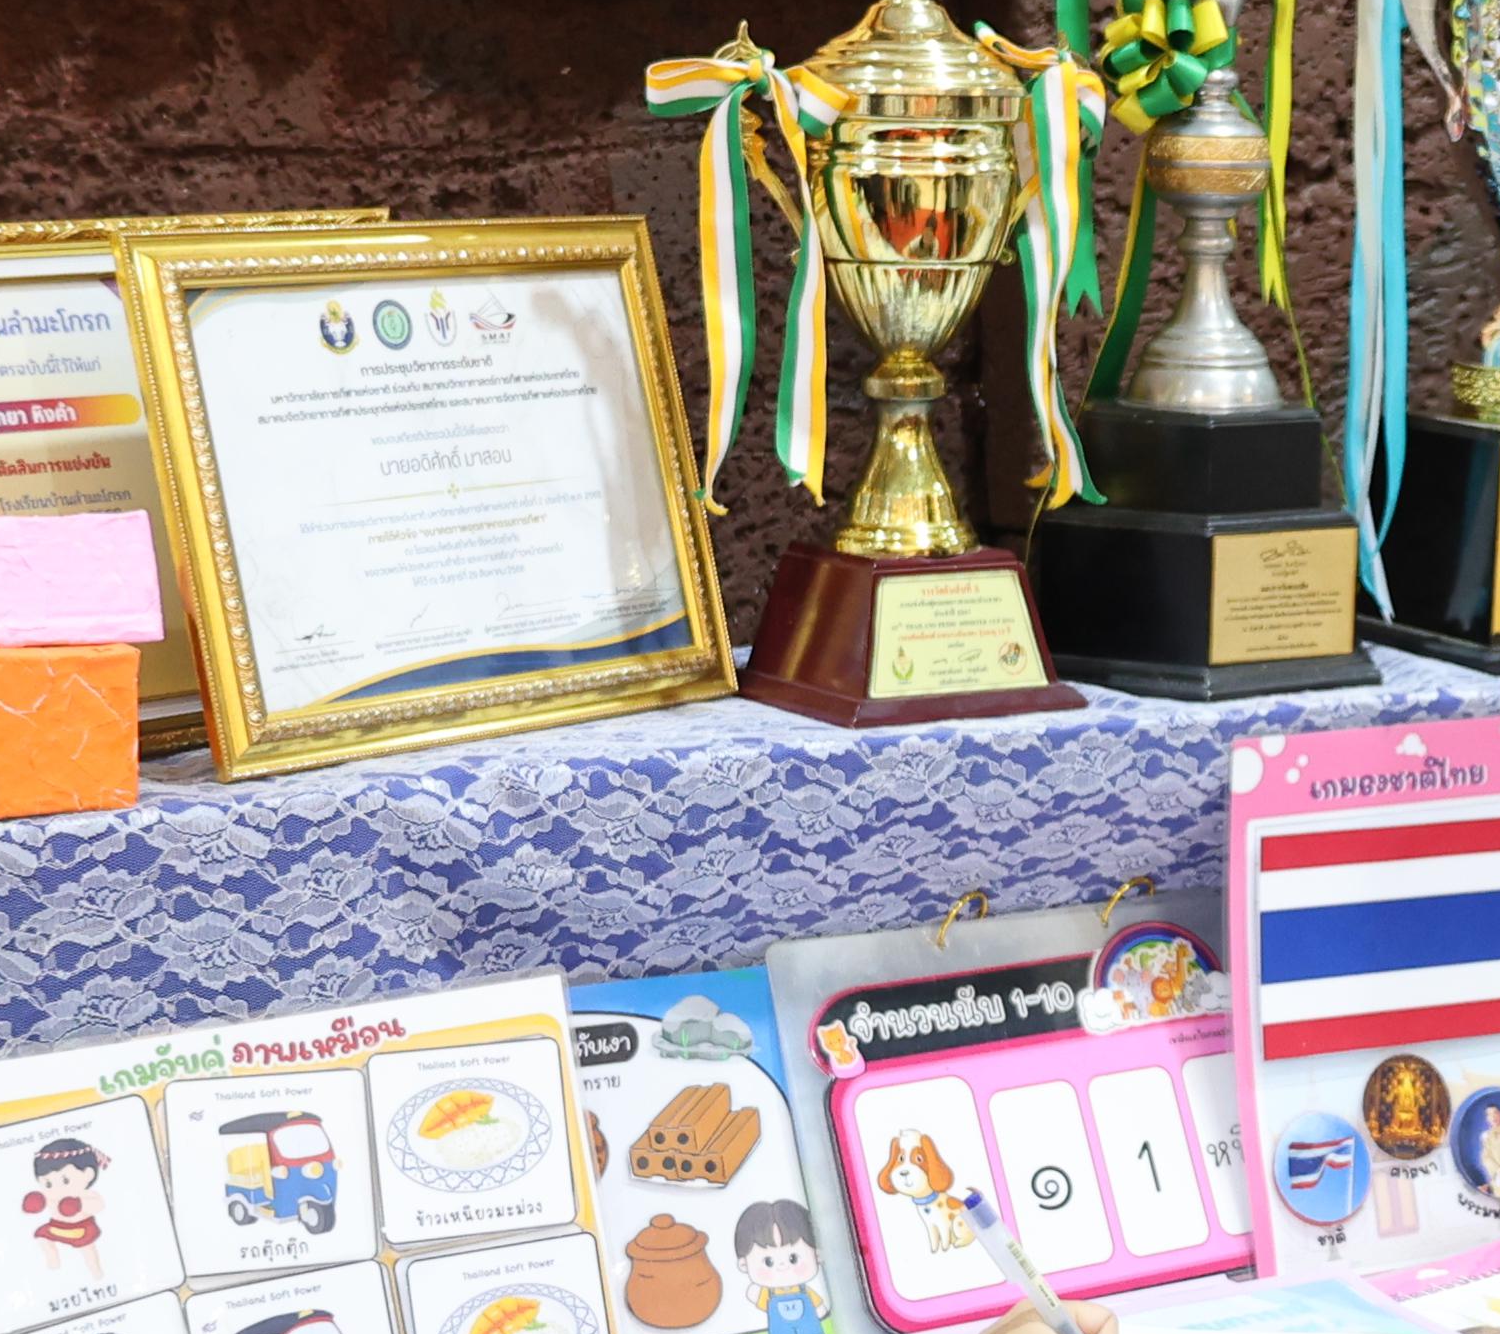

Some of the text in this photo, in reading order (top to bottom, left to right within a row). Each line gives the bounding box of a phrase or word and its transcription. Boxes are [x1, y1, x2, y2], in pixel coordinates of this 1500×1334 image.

[1310, 755, 1486, 801] เกมธงชาติไทย
[851, 983, 1072, 1045] จำนวนนับ 1-10
[232, 1015, 407, 1067] ภาพเหมือน
[1031, 1165, 1074, 1210] ๑
[1137, 1140, 1161, 1193] 1
[415, 1199, 544, 1228] ข้าวเหนียวมะม่วง
[48, 1281, 119, 1314] มวยไทย
